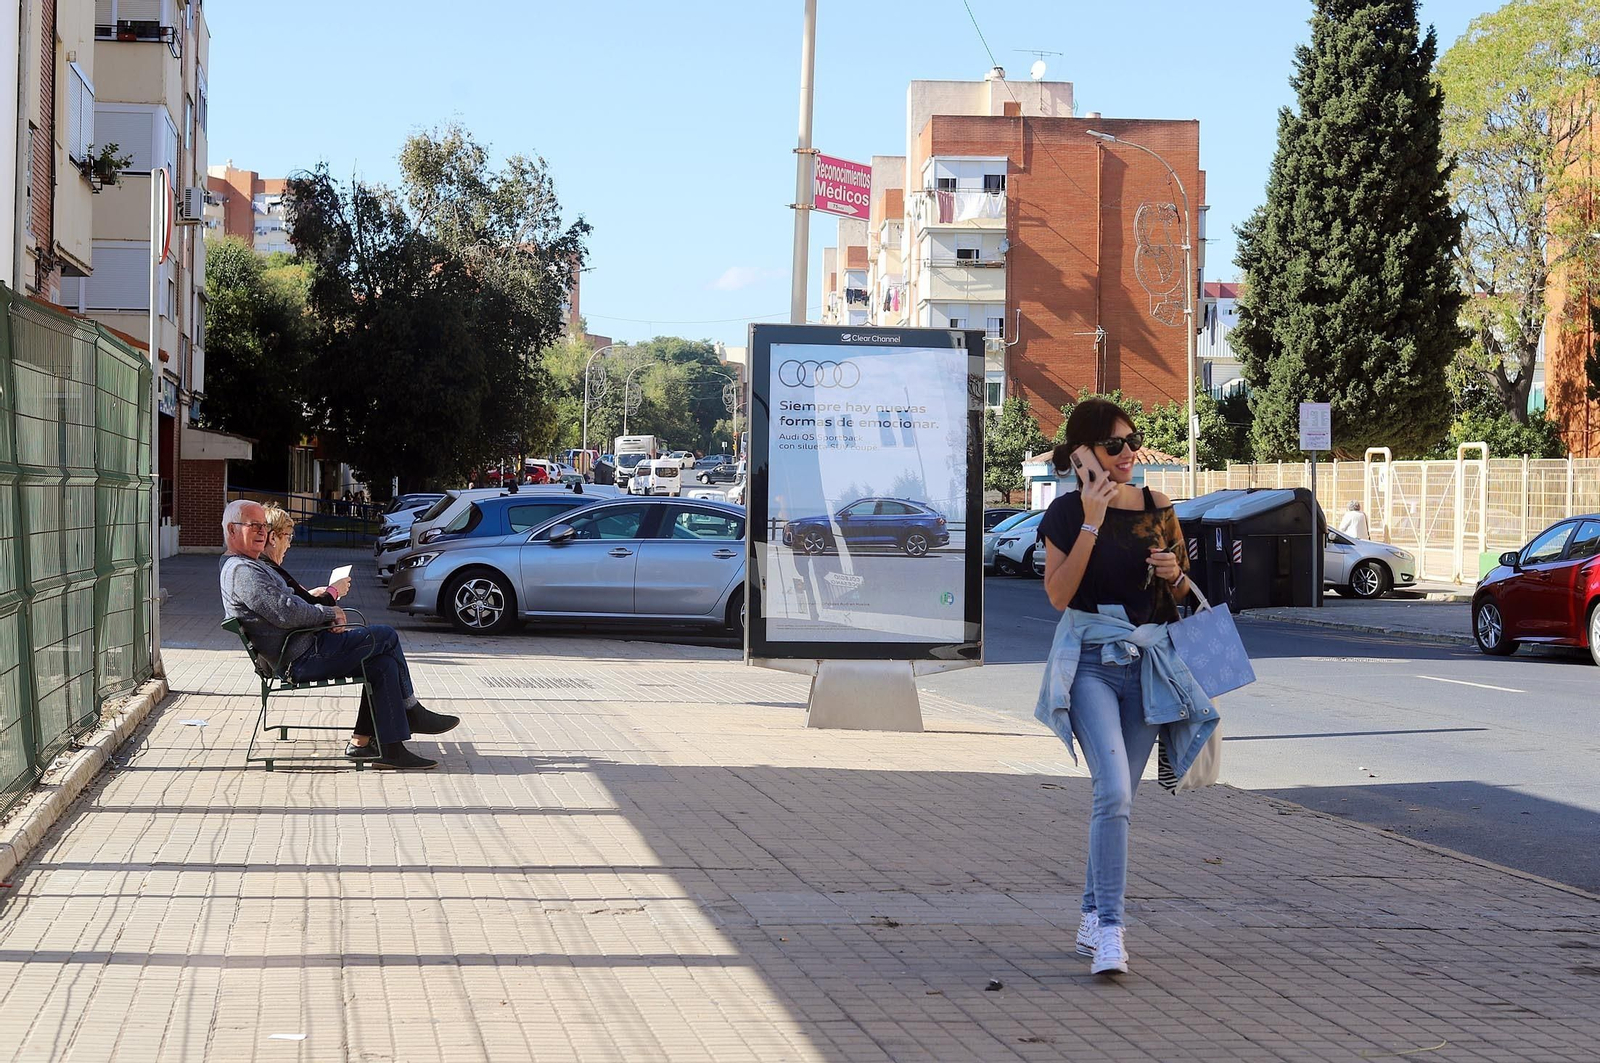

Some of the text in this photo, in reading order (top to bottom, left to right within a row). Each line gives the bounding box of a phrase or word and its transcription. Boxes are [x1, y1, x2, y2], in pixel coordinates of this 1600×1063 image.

[815, 156, 871, 189] Reconocimientos
[815, 179, 870, 206] Médicos
[872, 335, 901, 343] Channel
[779, 400, 927, 415] Siempre hay nuevas
[779, 415, 940, 429] formas de emocionar.
[779, 433, 800, 441] Audi
[817, 434, 863, 442] Sportback
